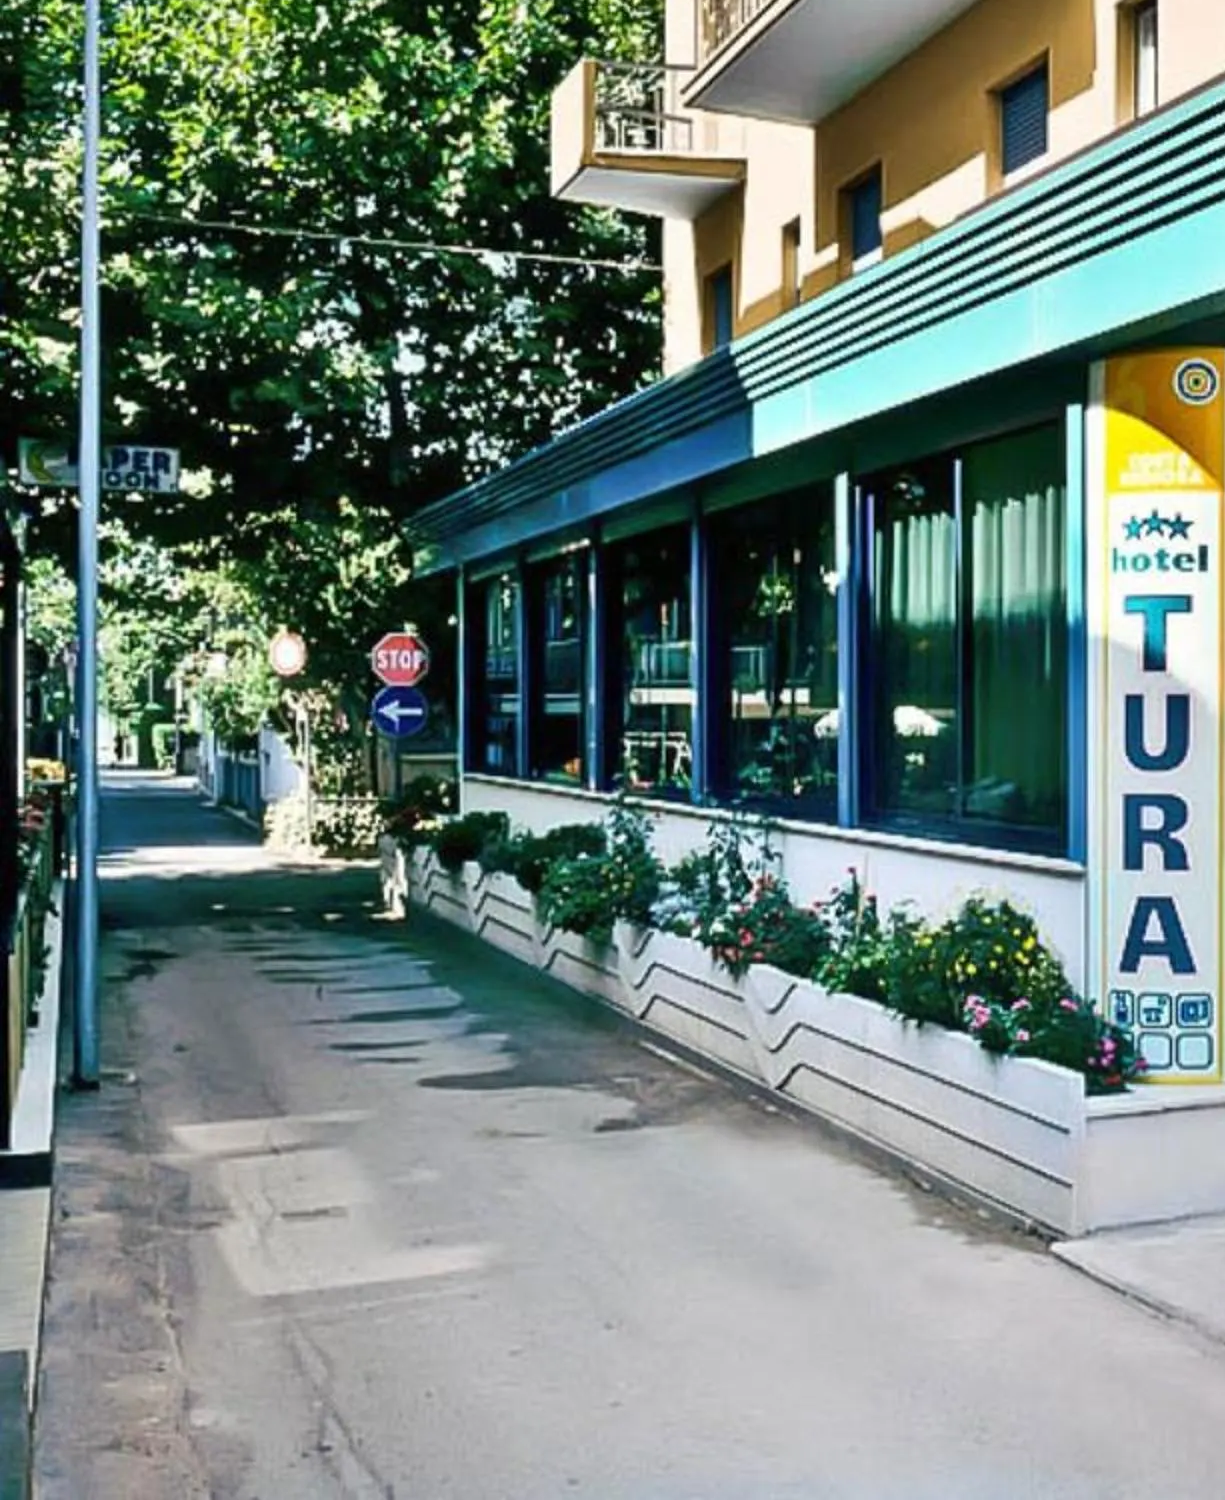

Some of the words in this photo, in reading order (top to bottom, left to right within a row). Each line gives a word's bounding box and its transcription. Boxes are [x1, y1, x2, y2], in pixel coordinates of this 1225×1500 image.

[1113, 545, 1209, 573] hotel
[377, 649, 425, 669] STOP
[1119, 594, 1197, 975] TURA
